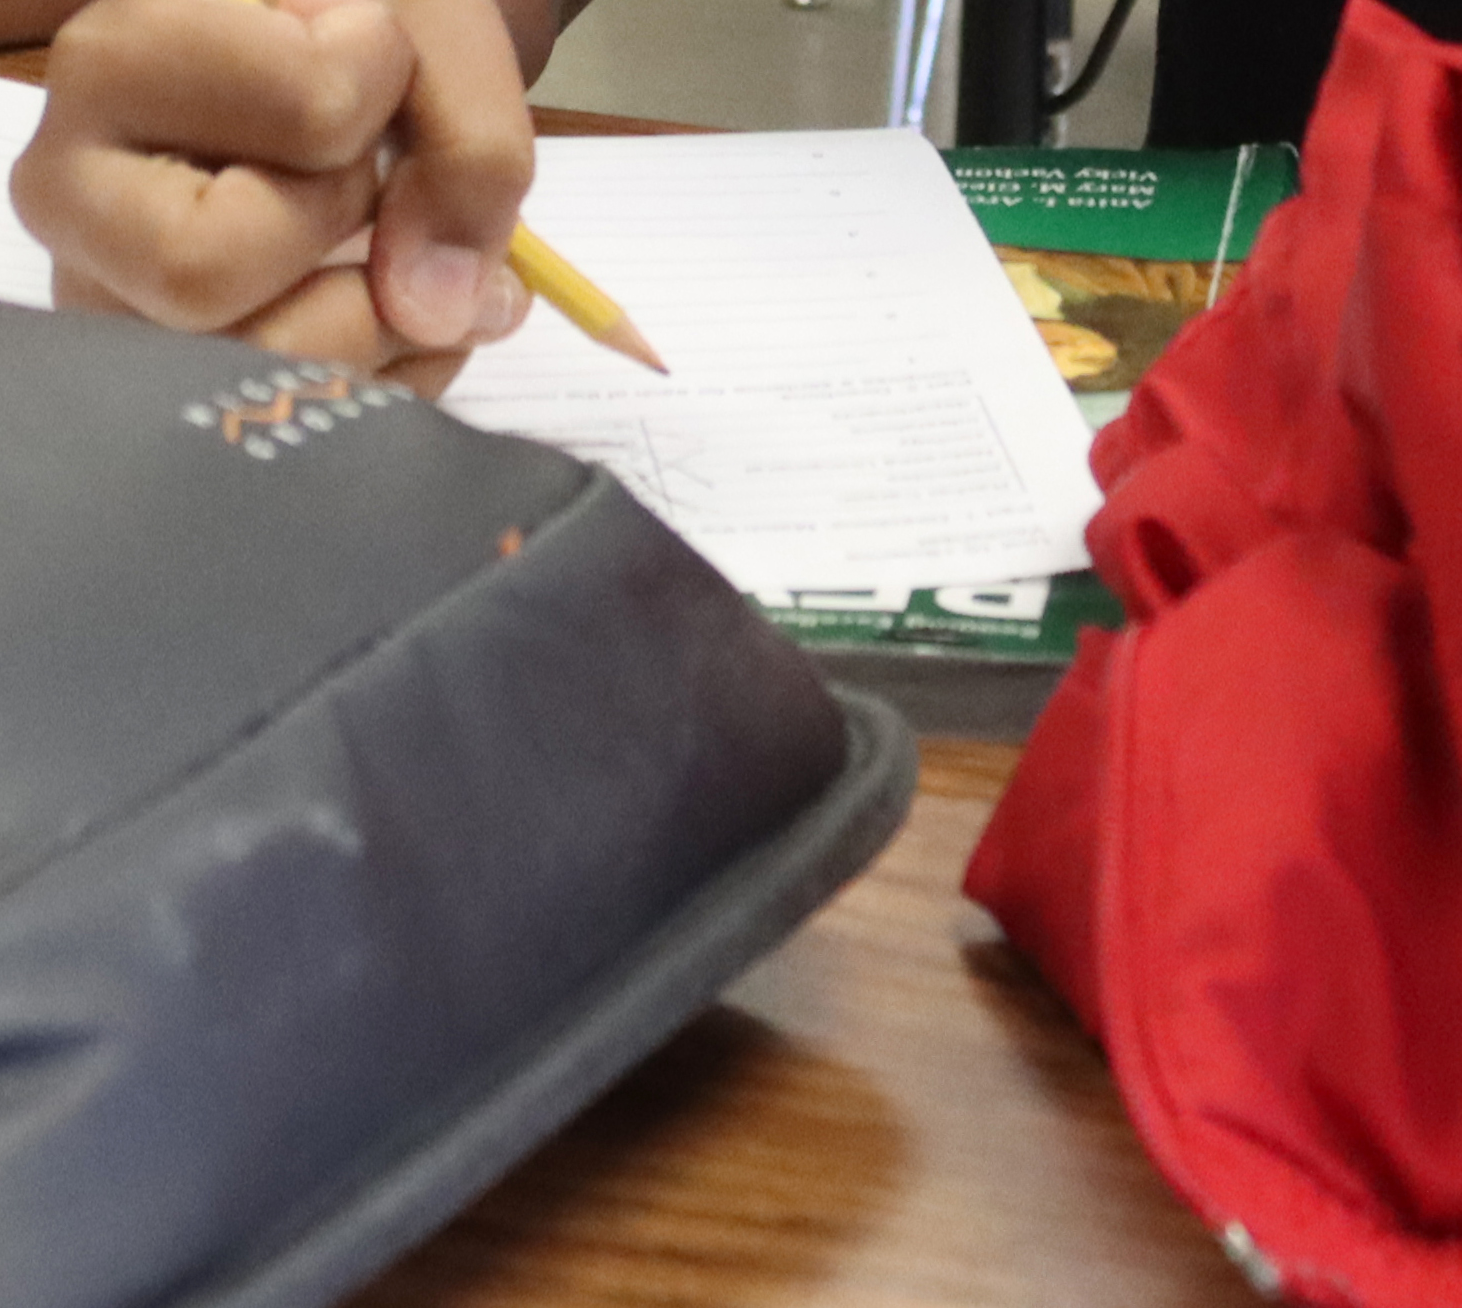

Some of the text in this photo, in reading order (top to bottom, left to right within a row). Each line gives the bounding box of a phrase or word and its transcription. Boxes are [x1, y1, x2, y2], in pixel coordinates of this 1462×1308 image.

[1074, 167, 1159, 183] Vicky
[1076, 181, 1156, 197] Mary
[1068, 196, 1154, 210] Anita
